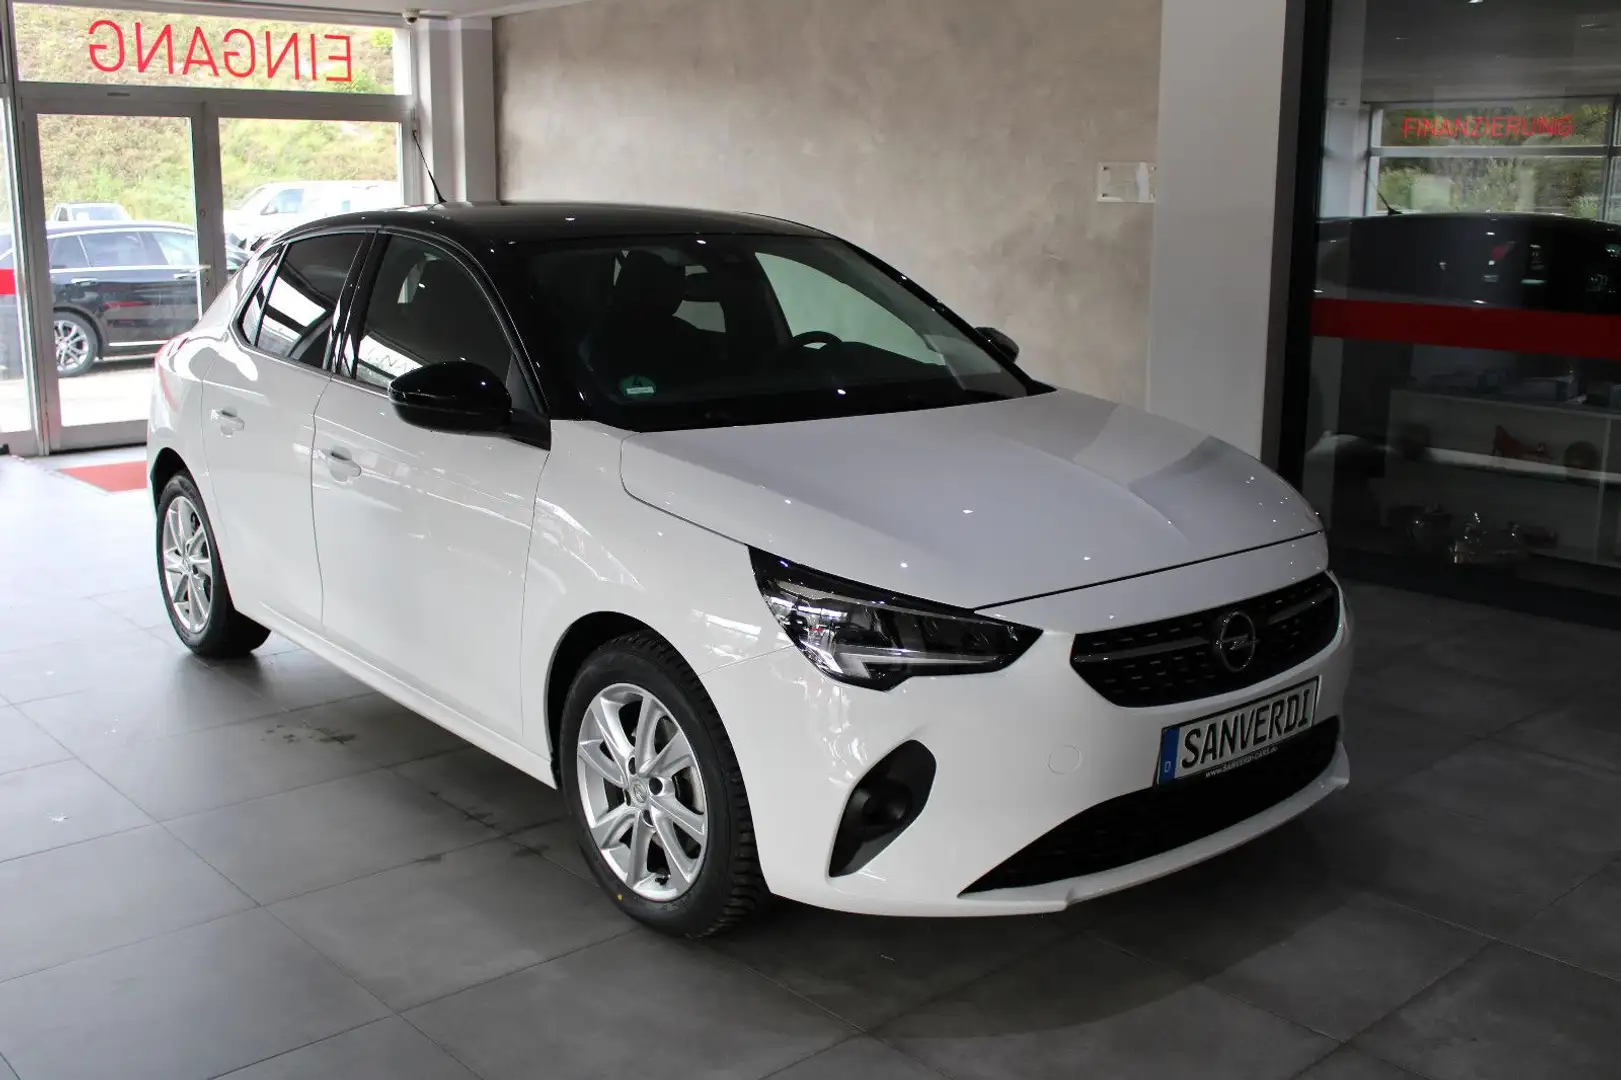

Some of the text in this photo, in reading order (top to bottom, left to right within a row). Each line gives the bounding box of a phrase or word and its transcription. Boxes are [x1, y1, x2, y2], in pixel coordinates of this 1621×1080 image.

[1402, 114, 1574, 138] FINANZIERUNG
[1182, 688, 1311, 769] SANVERDI
[1164, 760, 1172, 773] D
